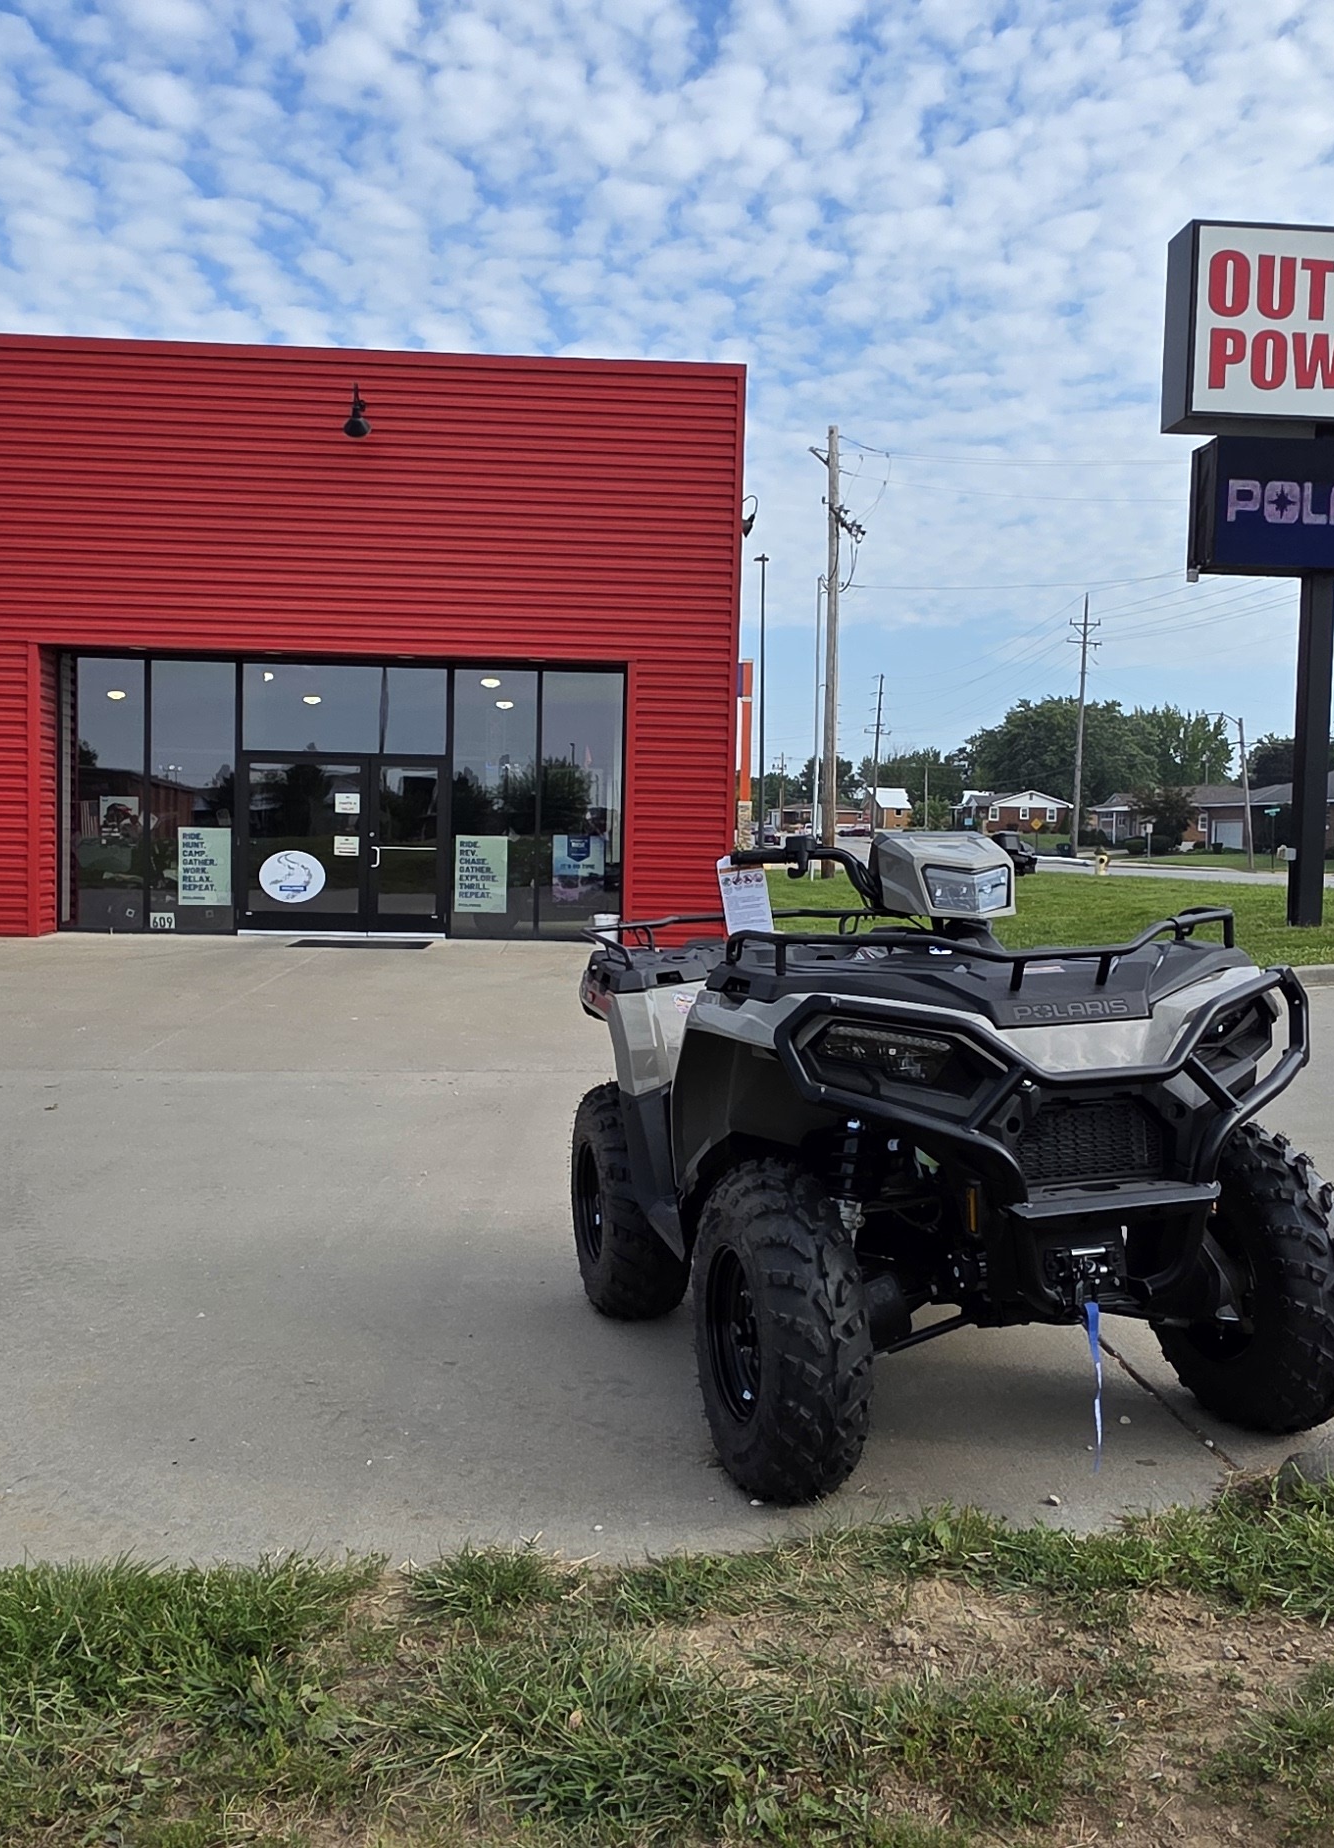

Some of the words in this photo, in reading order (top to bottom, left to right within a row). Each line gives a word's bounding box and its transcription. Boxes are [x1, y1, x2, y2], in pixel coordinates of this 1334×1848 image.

[182, 841, 207, 849] HUNT.
[459, 857, 489, 865] CHASE.
[182, 875, 213, 883] RELAX.
[182, 884, 217, 892] REPEAT.
[458, 891, 492, 899] REPEAT.
[152, 916, 173, 928] 609
[1013, 1000, 1128, 1020] POLARIS
